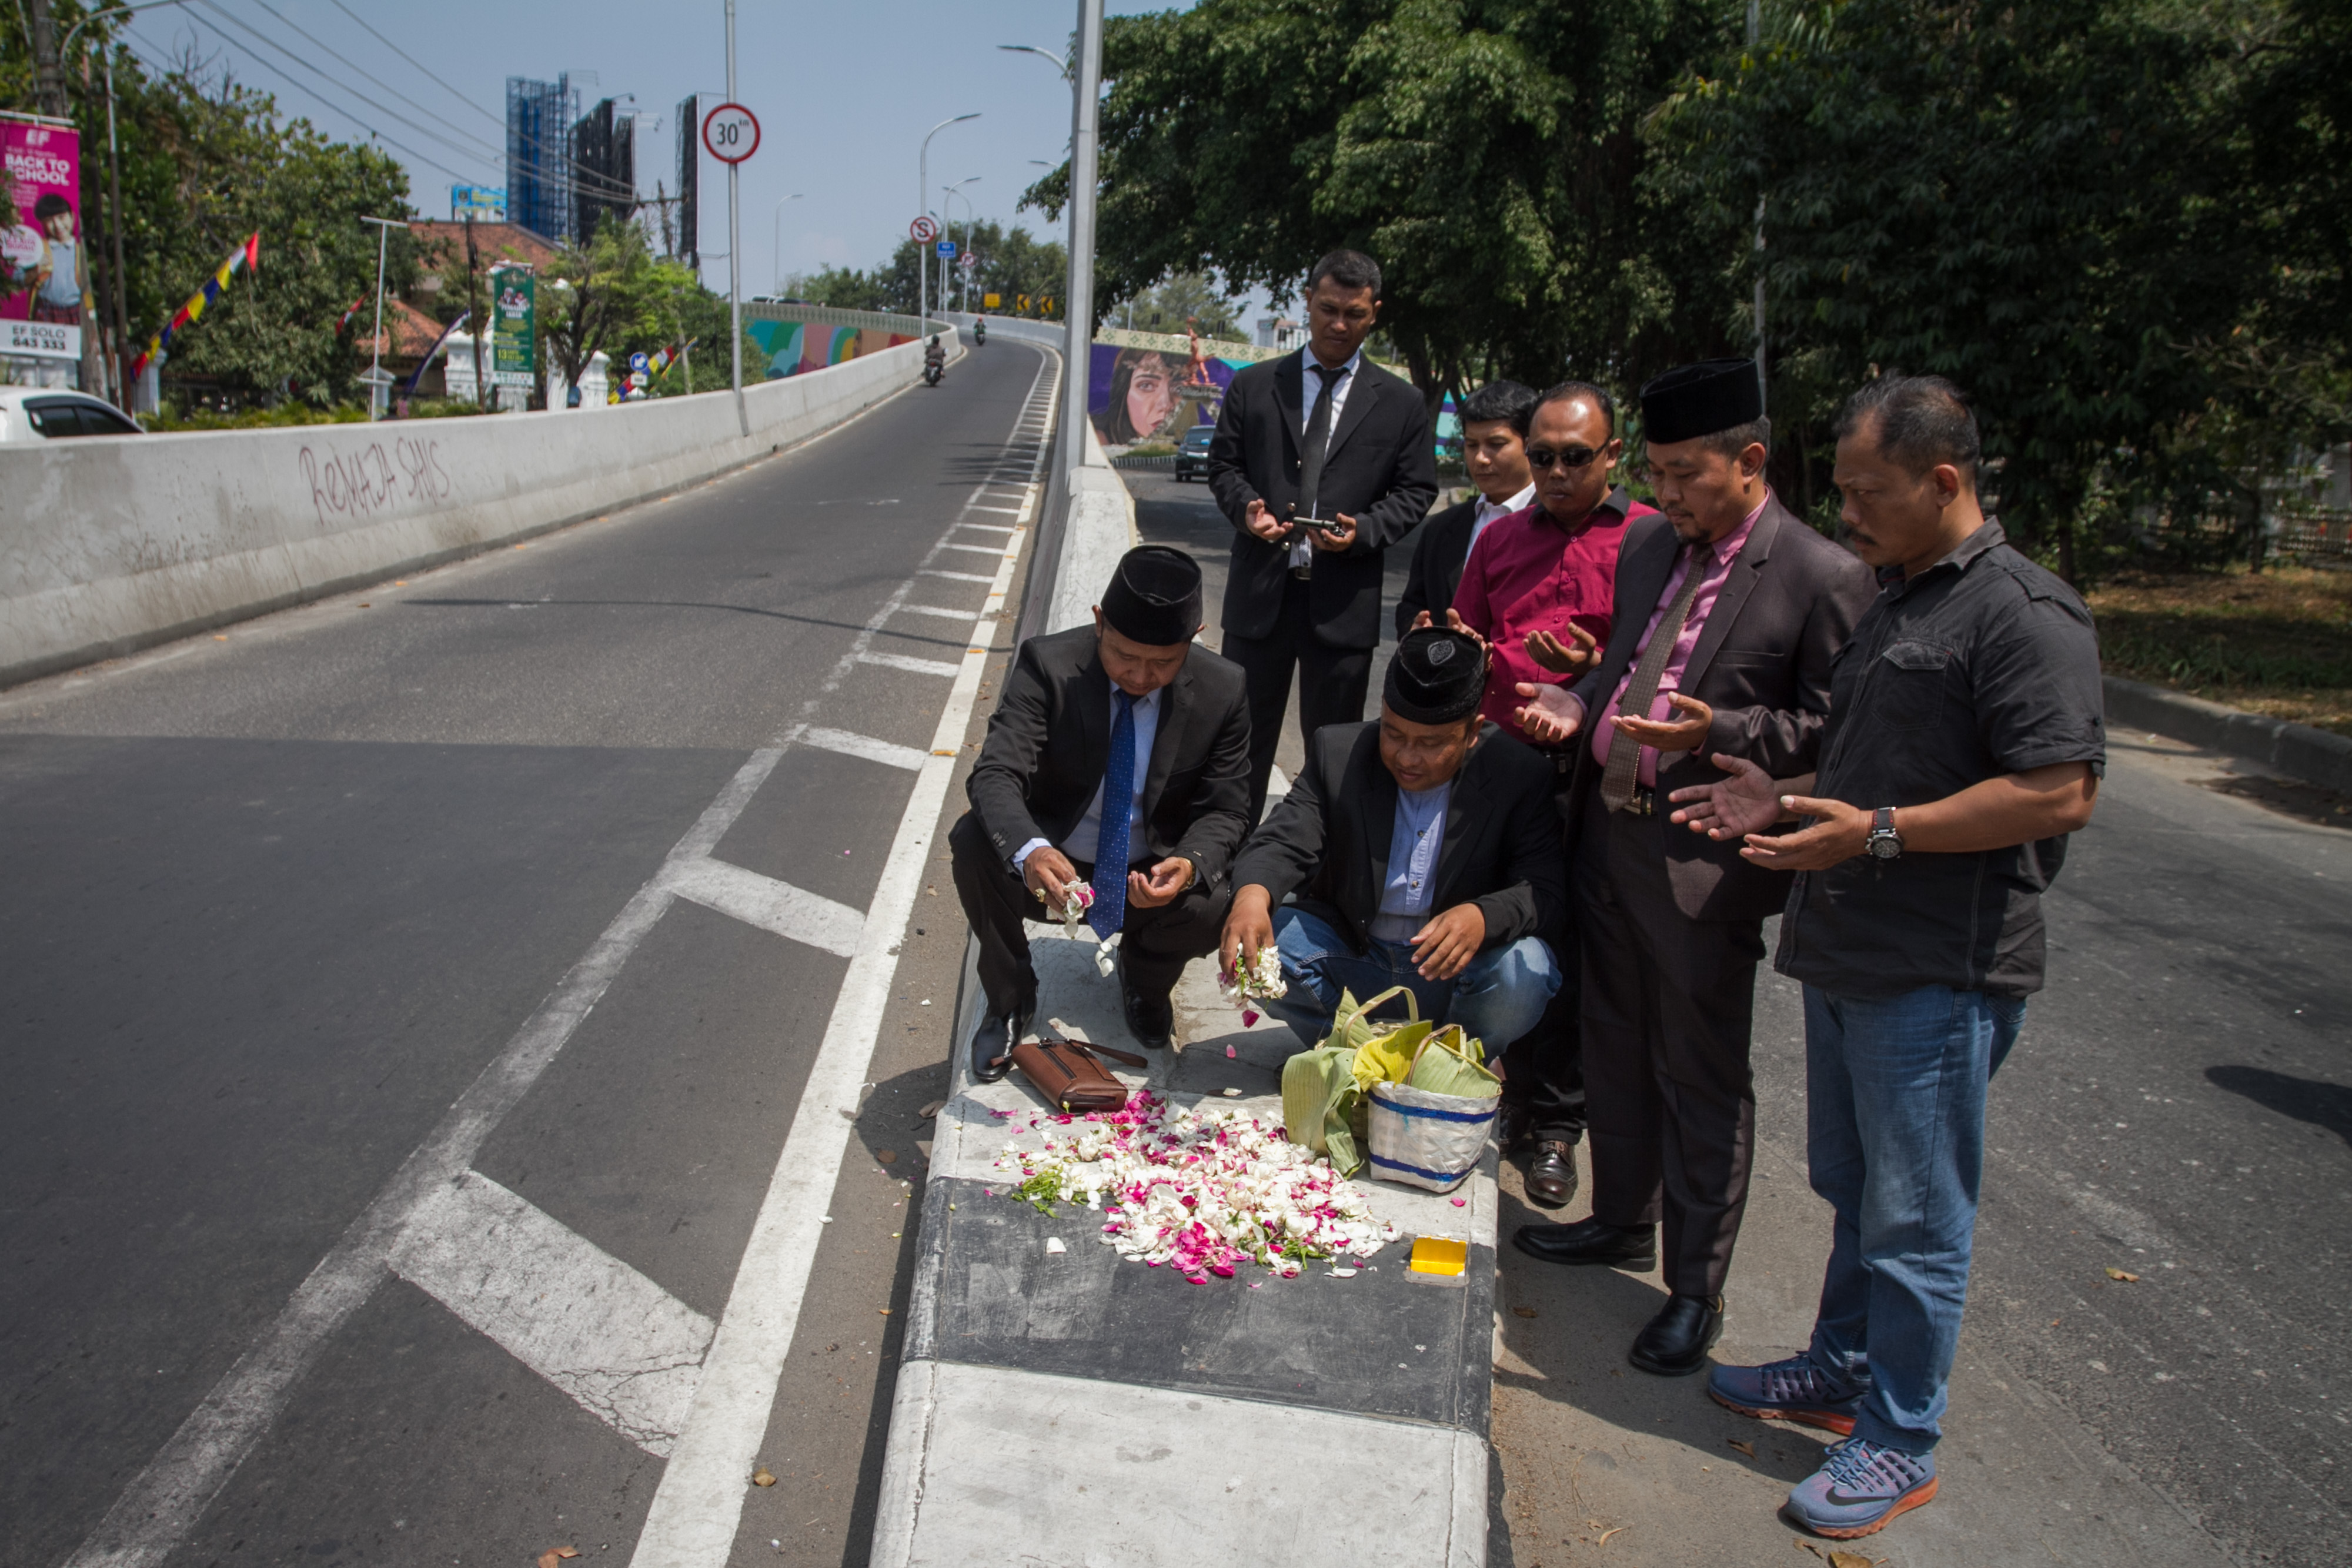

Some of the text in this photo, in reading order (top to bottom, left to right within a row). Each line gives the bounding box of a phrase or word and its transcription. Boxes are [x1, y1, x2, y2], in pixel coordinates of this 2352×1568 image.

[26, 128, 51, 146] EF
[717, 118, 749, 145] 30 km
[5, 153, 70, 174] BACK TO
[13, 325, 65, 339] EF SOLO
[12, 337, 38, 348] 643
